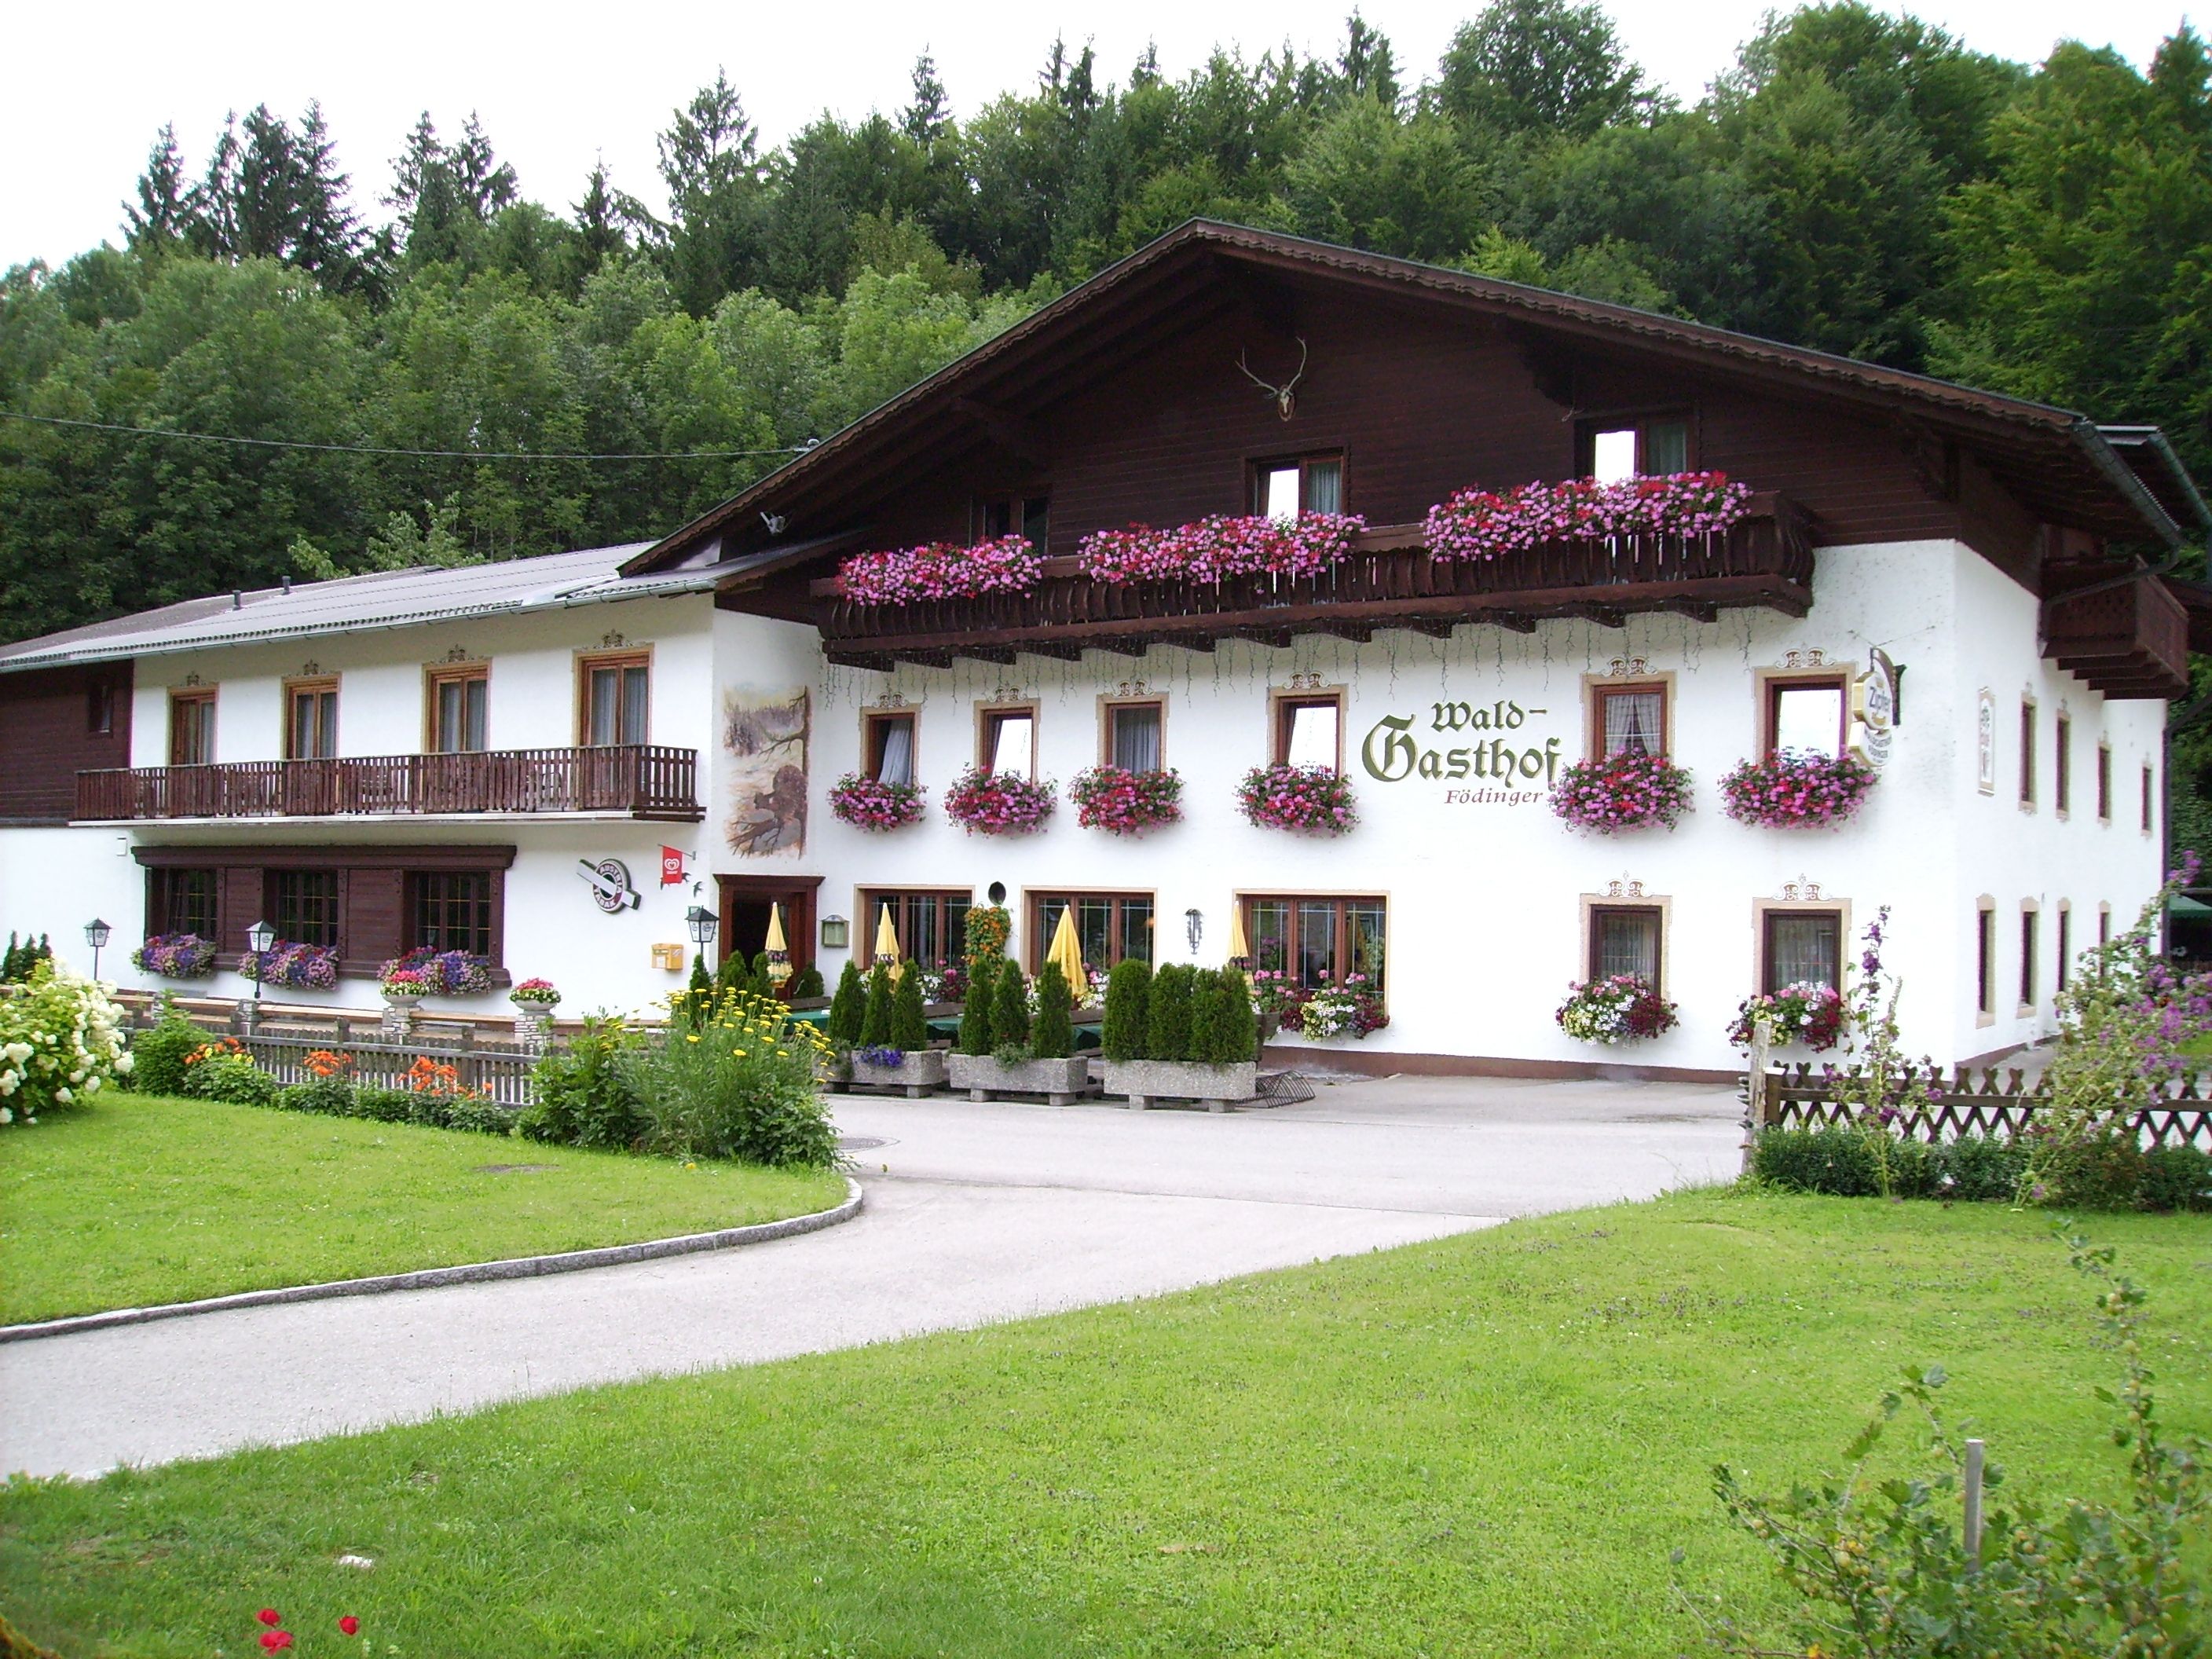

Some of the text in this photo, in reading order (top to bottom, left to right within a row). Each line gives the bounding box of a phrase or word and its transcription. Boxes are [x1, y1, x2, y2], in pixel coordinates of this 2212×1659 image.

[1430, 700, 1547, 732] Wald-
[1362, 713, 1562, 790] Gasthof
[1445, 788, 1543, 807] Födinger
[599, 864, 623, 894] AUSTRIA
[594, 888, 616, 907] TABAK
